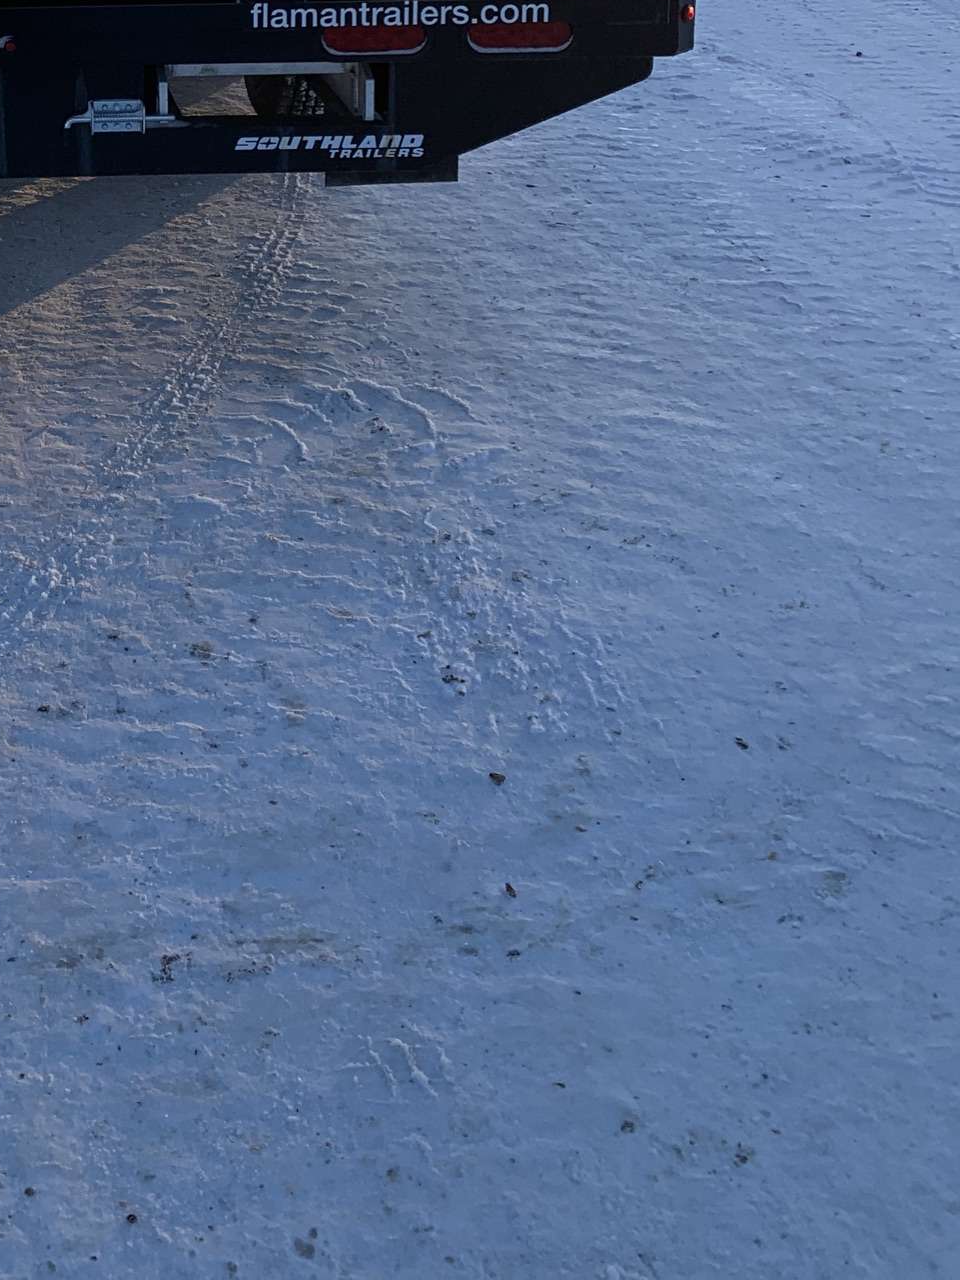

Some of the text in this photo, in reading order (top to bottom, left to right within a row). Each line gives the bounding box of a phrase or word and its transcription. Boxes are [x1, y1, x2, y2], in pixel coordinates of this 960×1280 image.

[250, 0, 550, 29] flamantrailers.com
[234, 134, 425, 151] SOUTHLAND
[329, 147, 425, 159] TRAILERS
